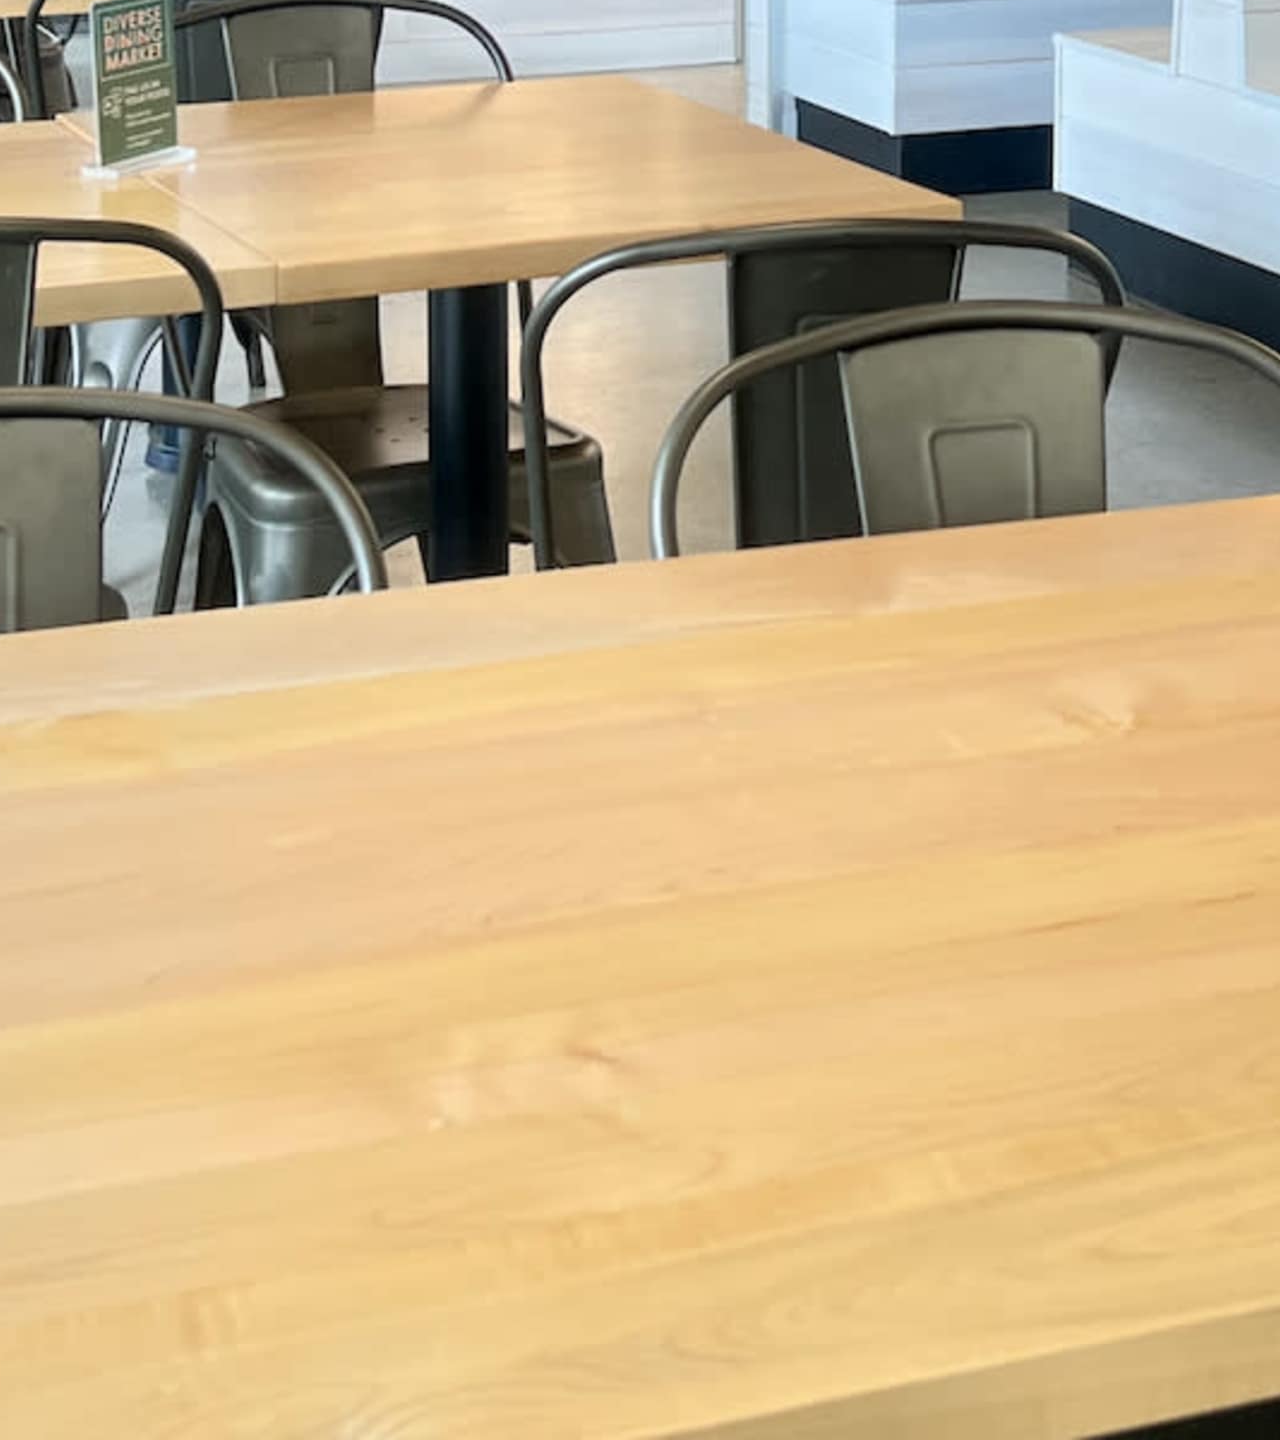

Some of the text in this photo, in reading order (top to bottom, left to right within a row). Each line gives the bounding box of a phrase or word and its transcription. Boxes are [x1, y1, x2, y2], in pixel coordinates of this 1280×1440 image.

[103, 6, 161, 35] DIVERSE
[104, 24, 163, 53] DINING
[105, 43, 162, 72] MARKET
